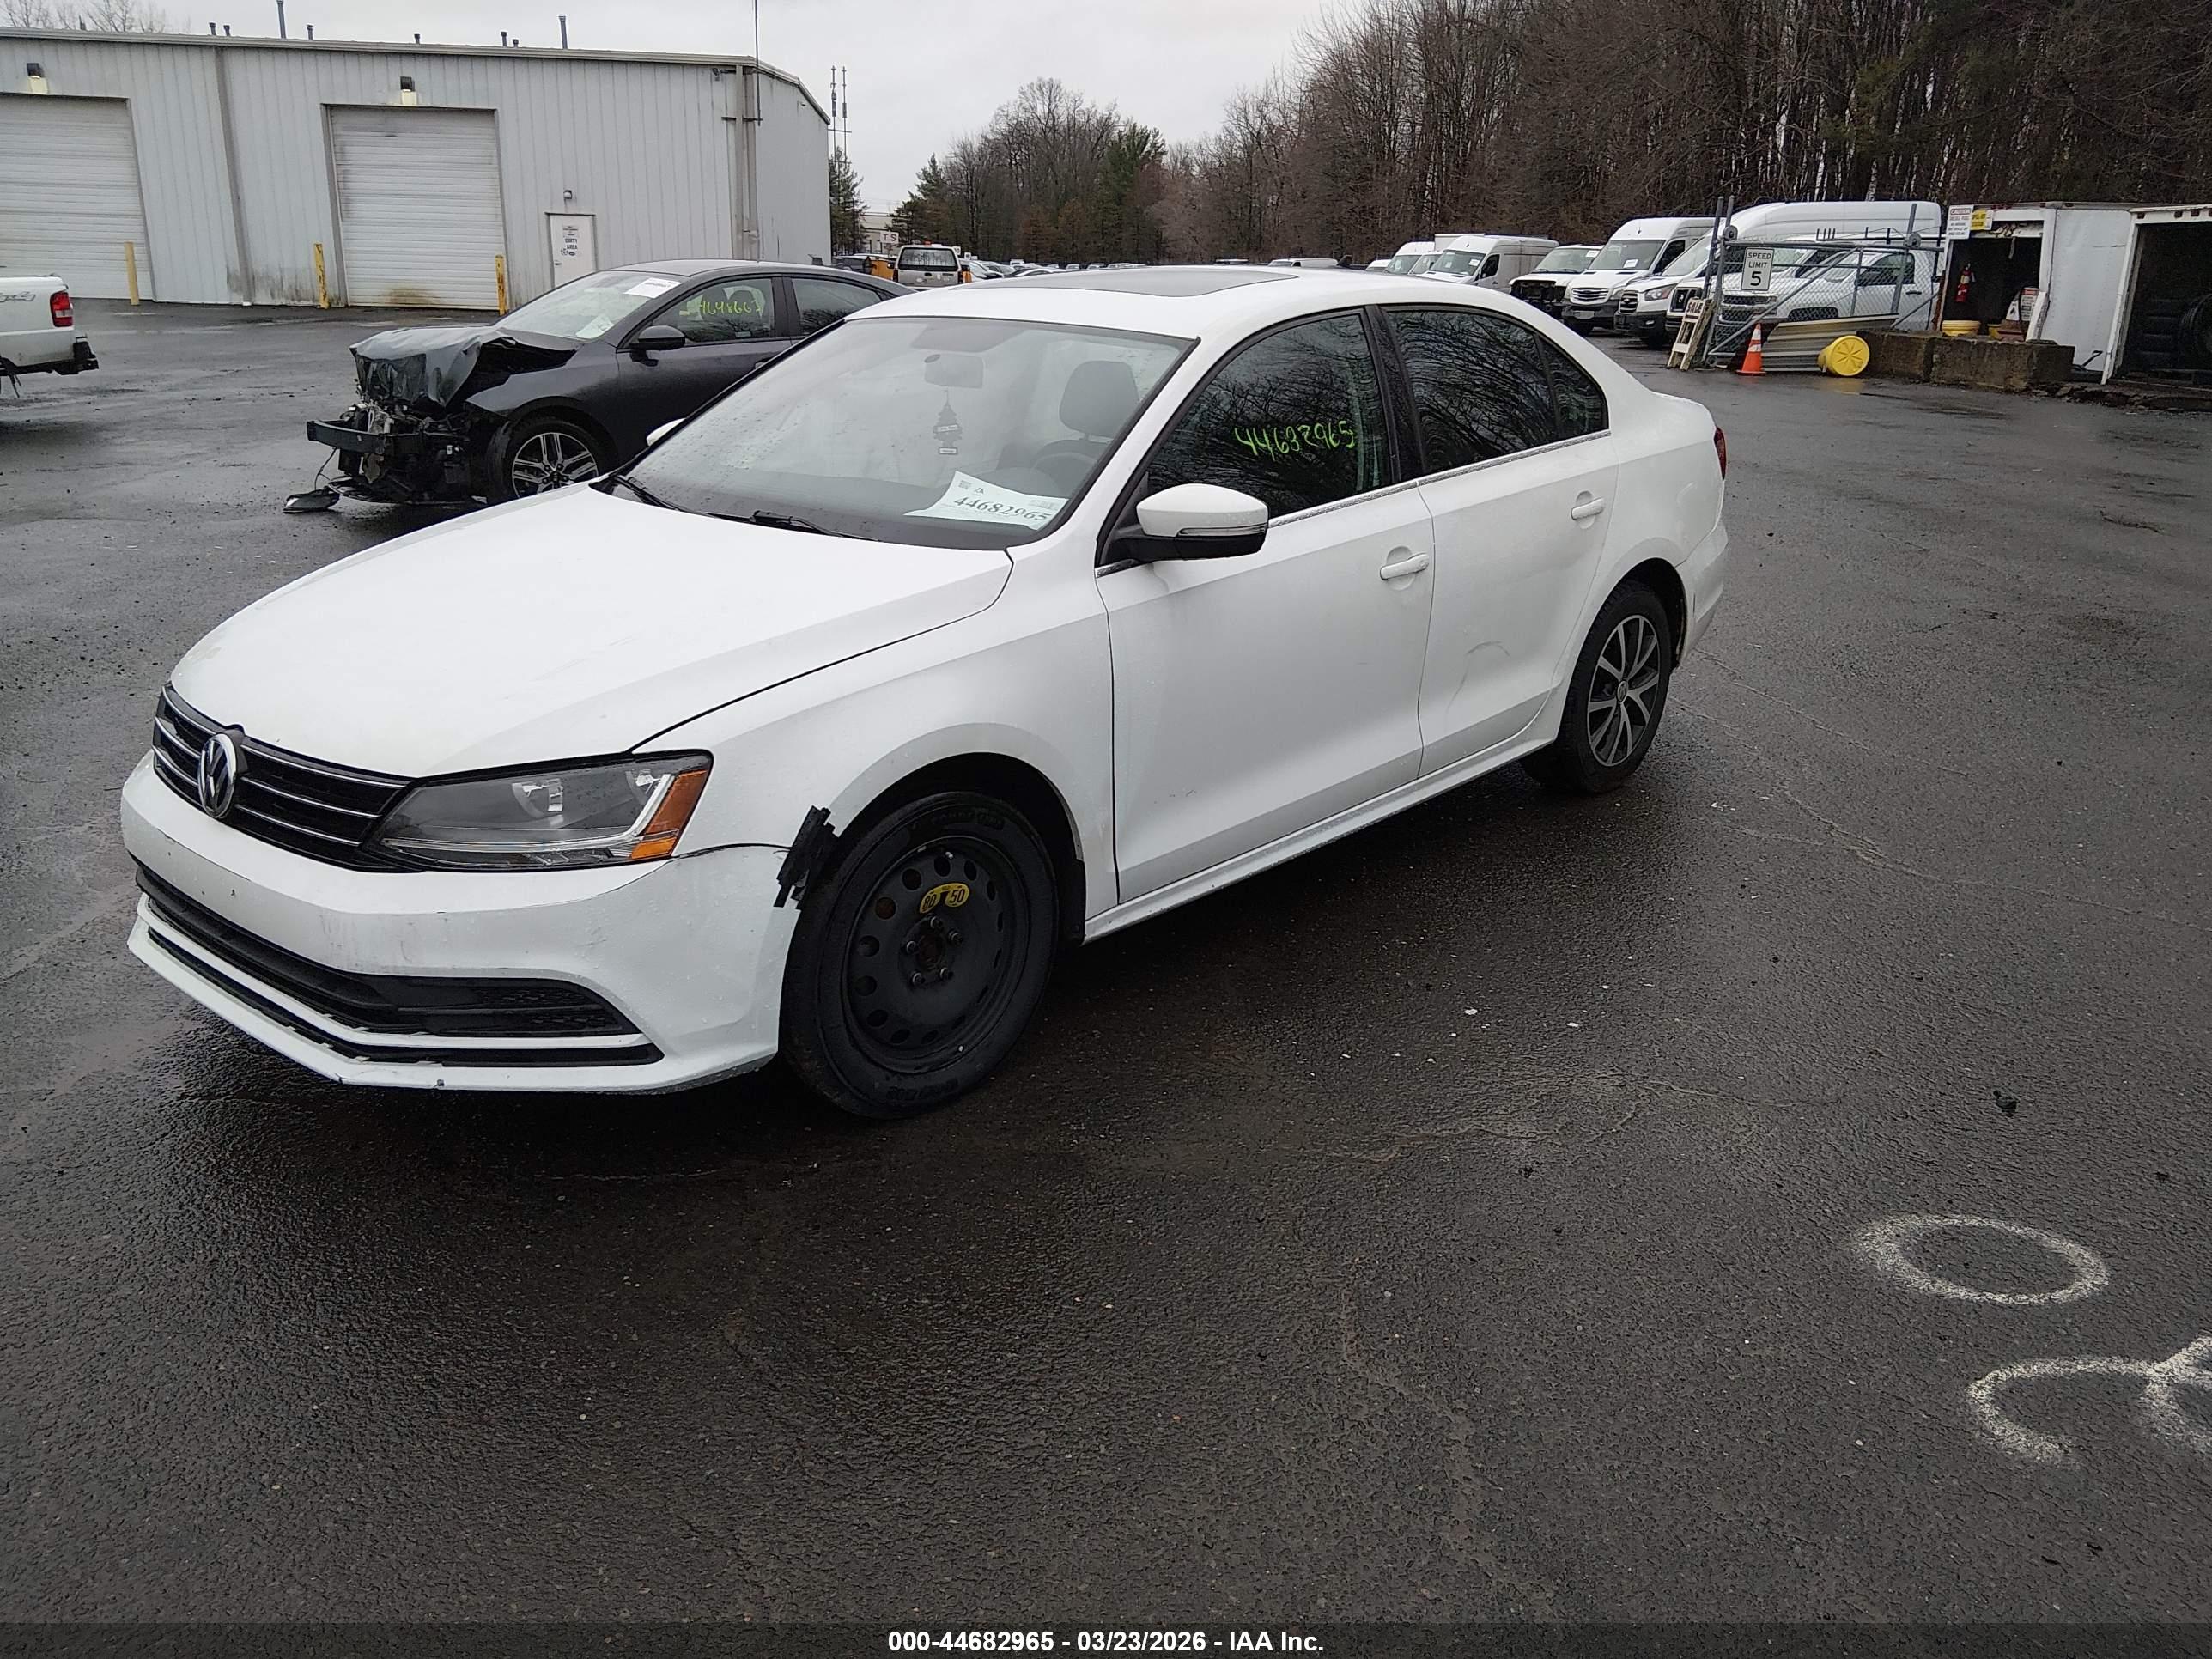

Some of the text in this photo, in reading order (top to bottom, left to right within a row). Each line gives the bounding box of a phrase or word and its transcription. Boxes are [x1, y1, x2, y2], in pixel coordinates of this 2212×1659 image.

[1750, 270, 1762, 286] 5
[1234, 420, 1356, 462] 44682965
[954, 496, 1053, 520] 44682965
